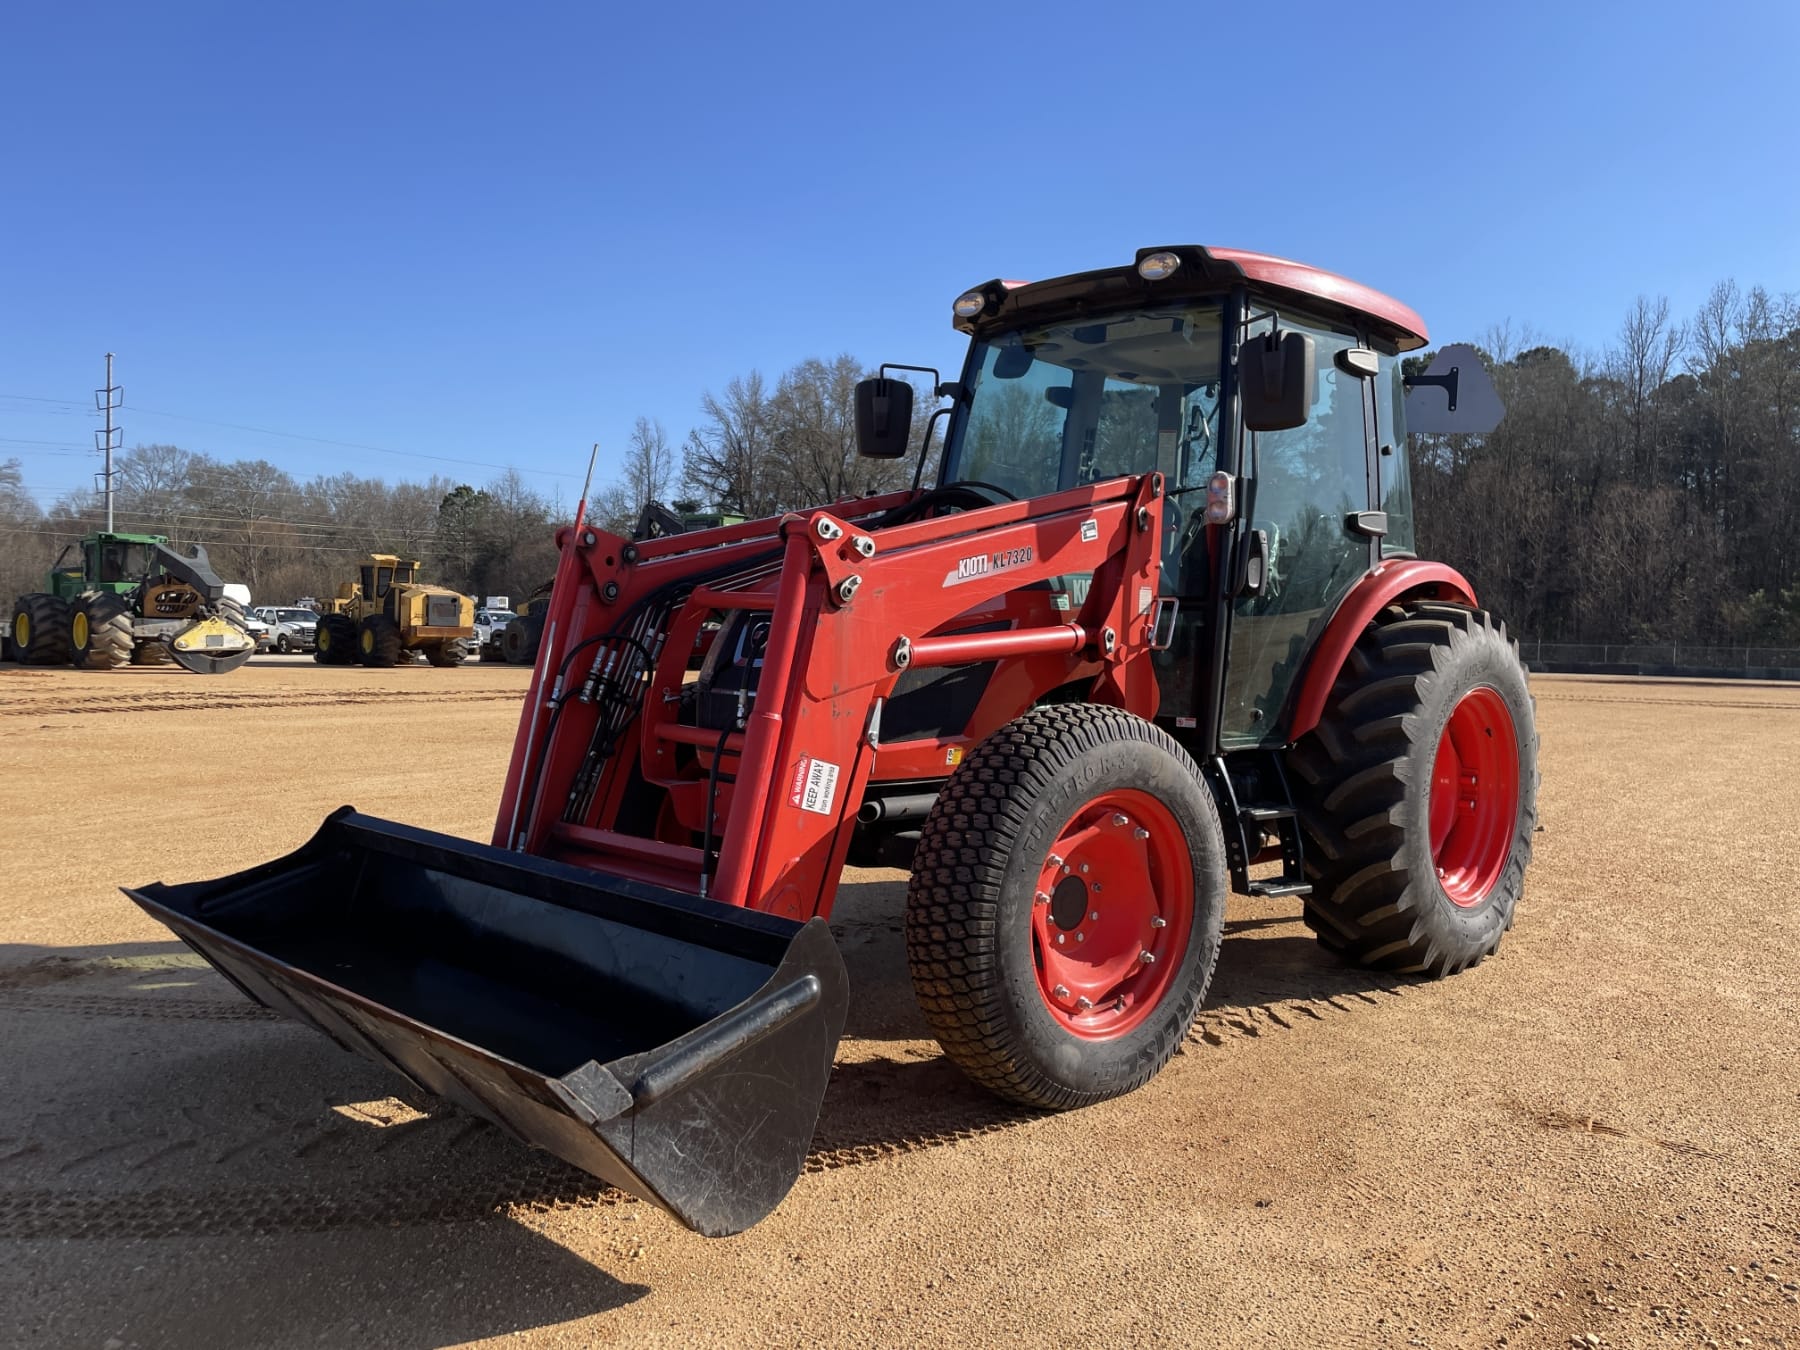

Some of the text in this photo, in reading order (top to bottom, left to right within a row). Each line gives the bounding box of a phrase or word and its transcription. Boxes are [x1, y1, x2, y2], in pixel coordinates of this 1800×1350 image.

[958, 546, 1033, 579] KIOTI KL7320
[805, 762, 824, 809] KEEP AWAY
